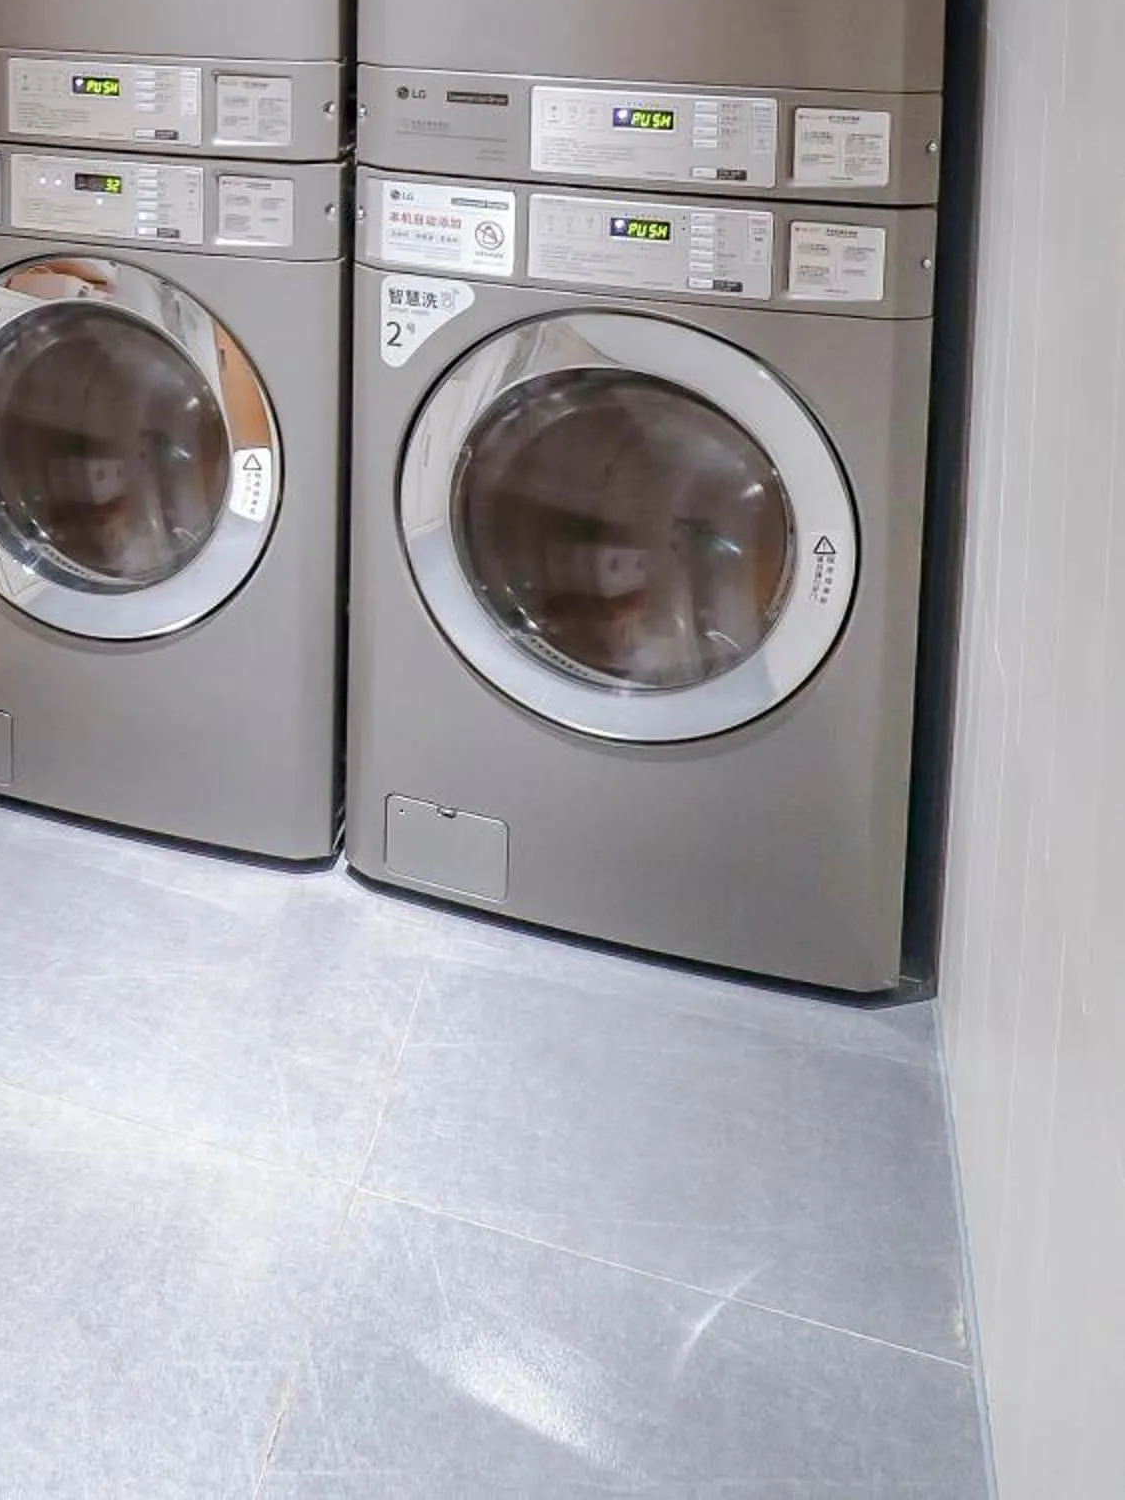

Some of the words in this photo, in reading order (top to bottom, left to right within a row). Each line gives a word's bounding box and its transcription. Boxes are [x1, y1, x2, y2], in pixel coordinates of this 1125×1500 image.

[86, 79, 119, 94] PUSH
[630, 111, 671, 128] PUSH
[626, 222, 668, 239] PUSH
[387, 287, 438, 309] 智慧洗
